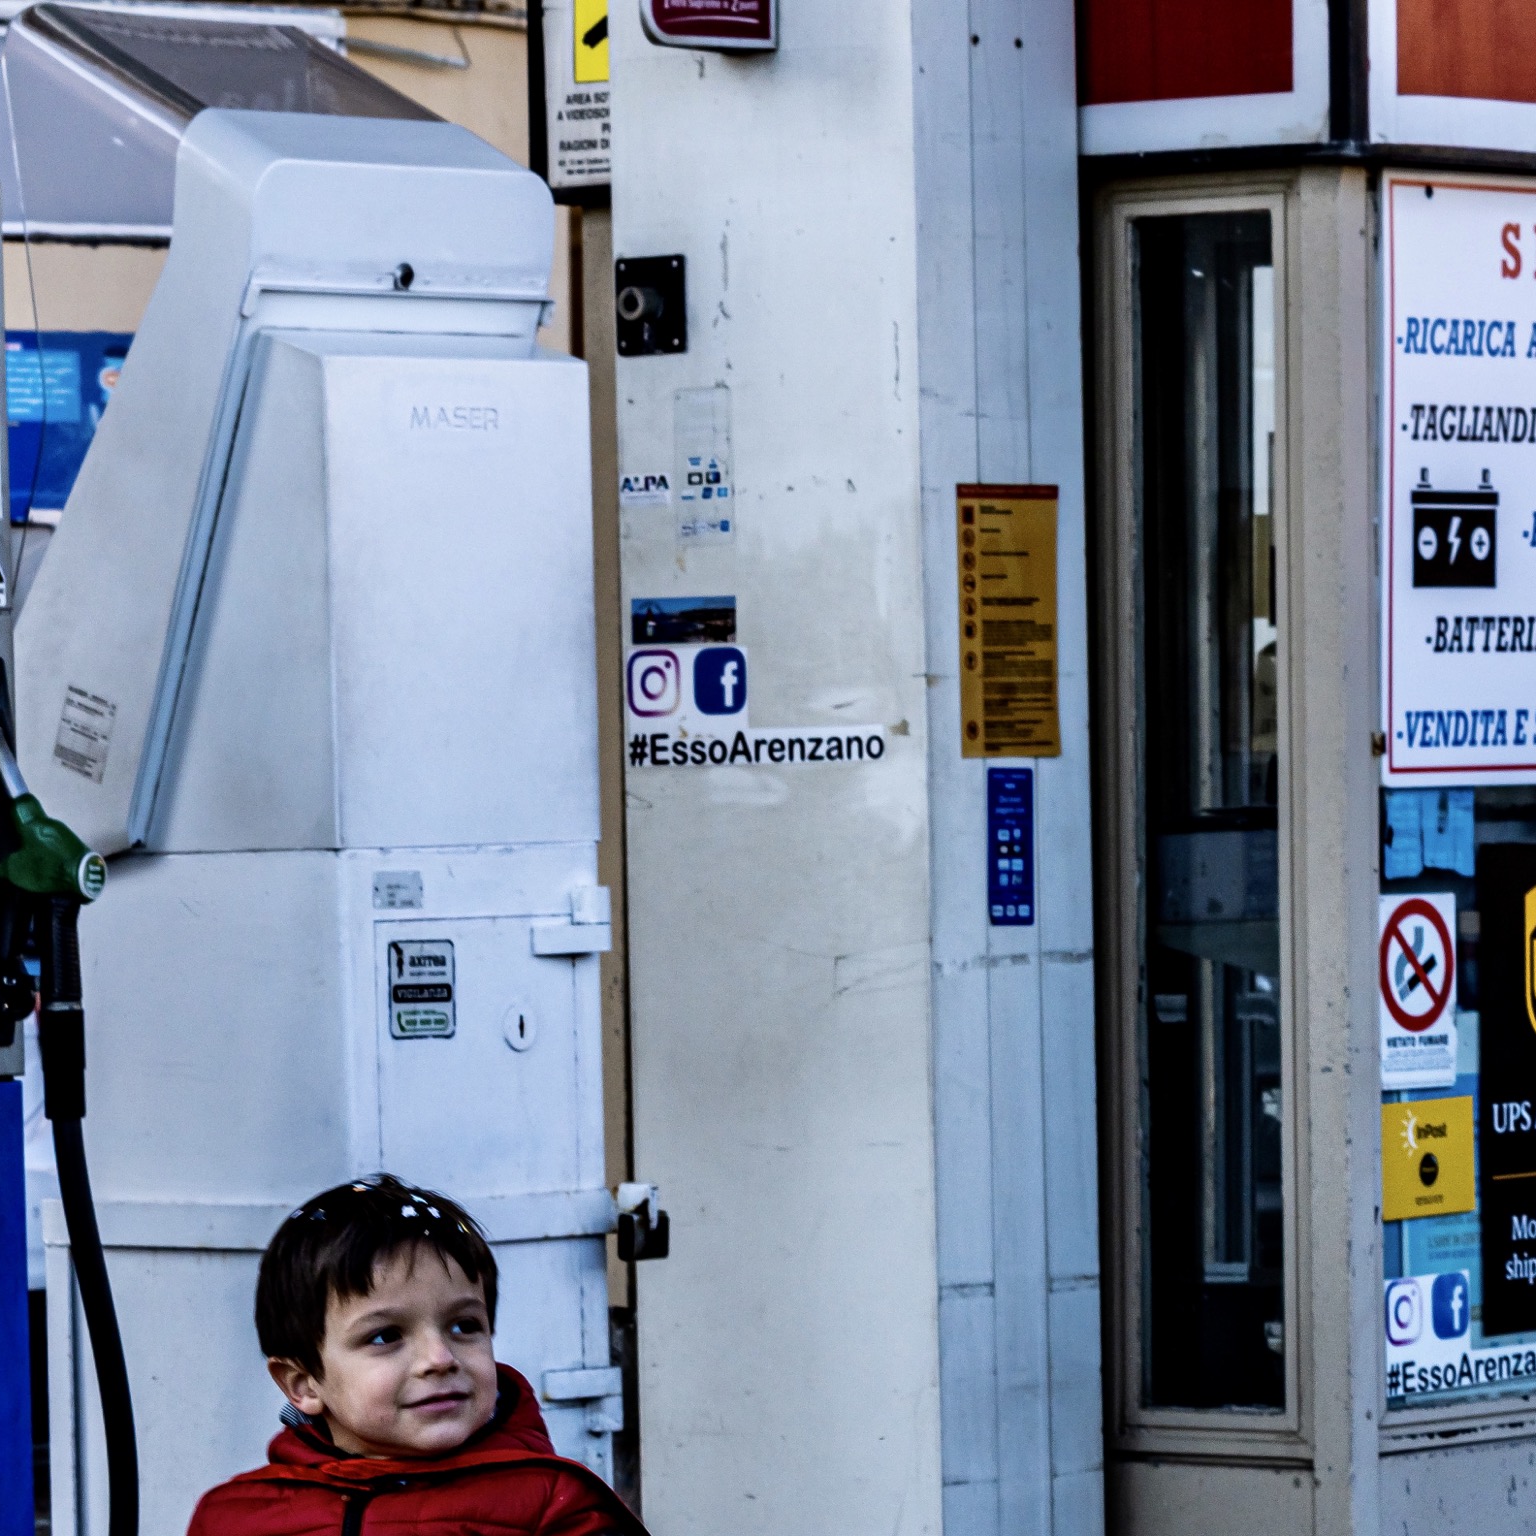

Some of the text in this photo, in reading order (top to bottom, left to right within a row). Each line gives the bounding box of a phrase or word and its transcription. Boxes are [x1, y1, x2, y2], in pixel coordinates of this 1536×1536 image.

[566, 93, 591, 105] AREA
[1396, 317, 1516, 358] -RICARICA
[409, 405, 499, 431] MASER
[1396, 709, 1508, 748] -VENDITA
[1512, 708, 1527, 747] E
[629, 731, 885, 768] #EssoArenzano
[1386, 1034, 1449, 1048] VIETATO FUMARE
[1416, 1122, 1447, 1140] InPost
[1492, 1101, 1532, 1134] UPS
